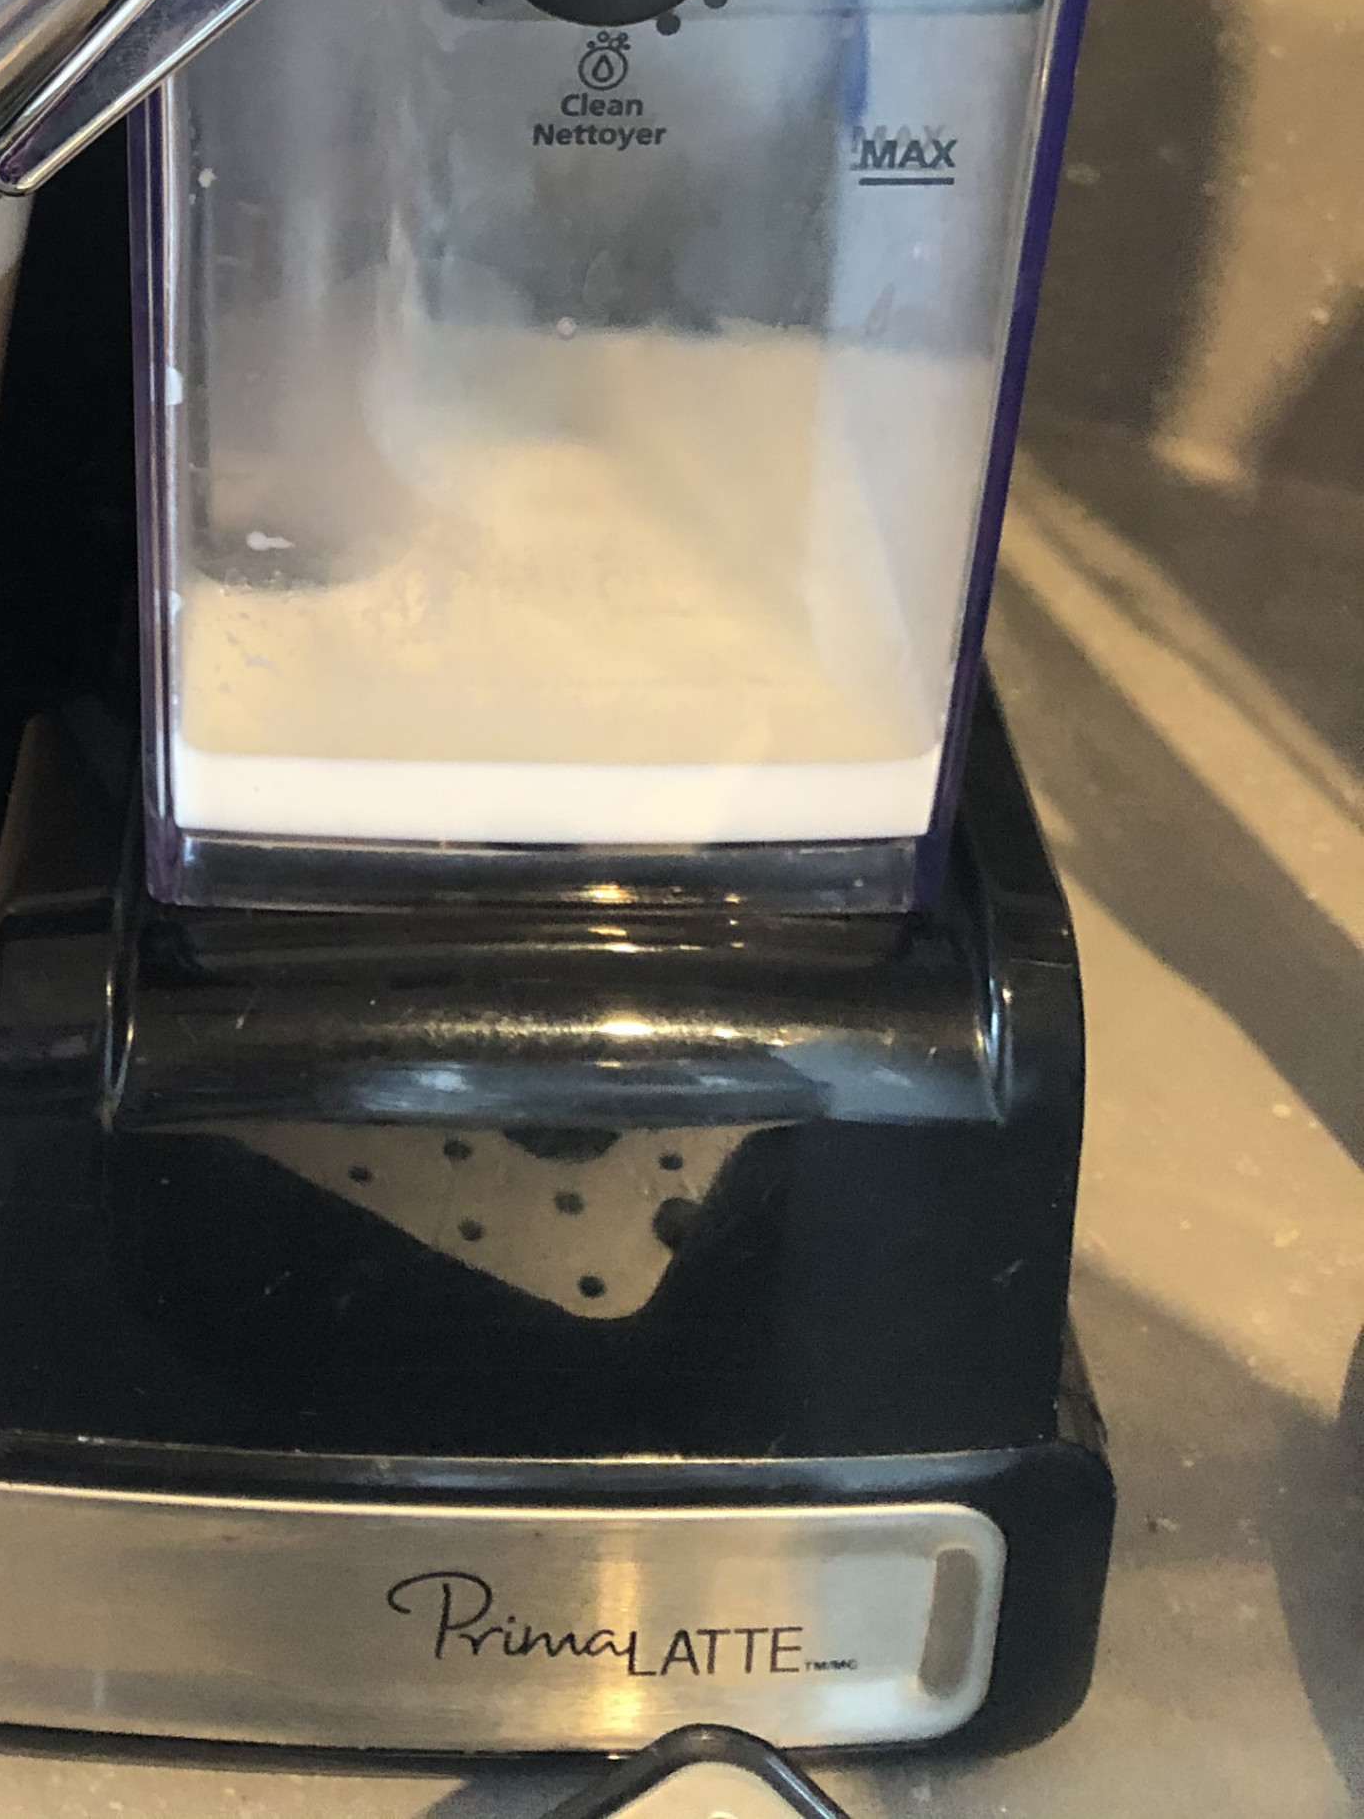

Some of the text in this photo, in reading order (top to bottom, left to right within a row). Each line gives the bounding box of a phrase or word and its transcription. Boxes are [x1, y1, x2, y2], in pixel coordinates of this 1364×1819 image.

[559, 93, 644, 117] Clean
[532, 124, 667, 151] Nettoyer
[857, 138, 958, 170] MAX
